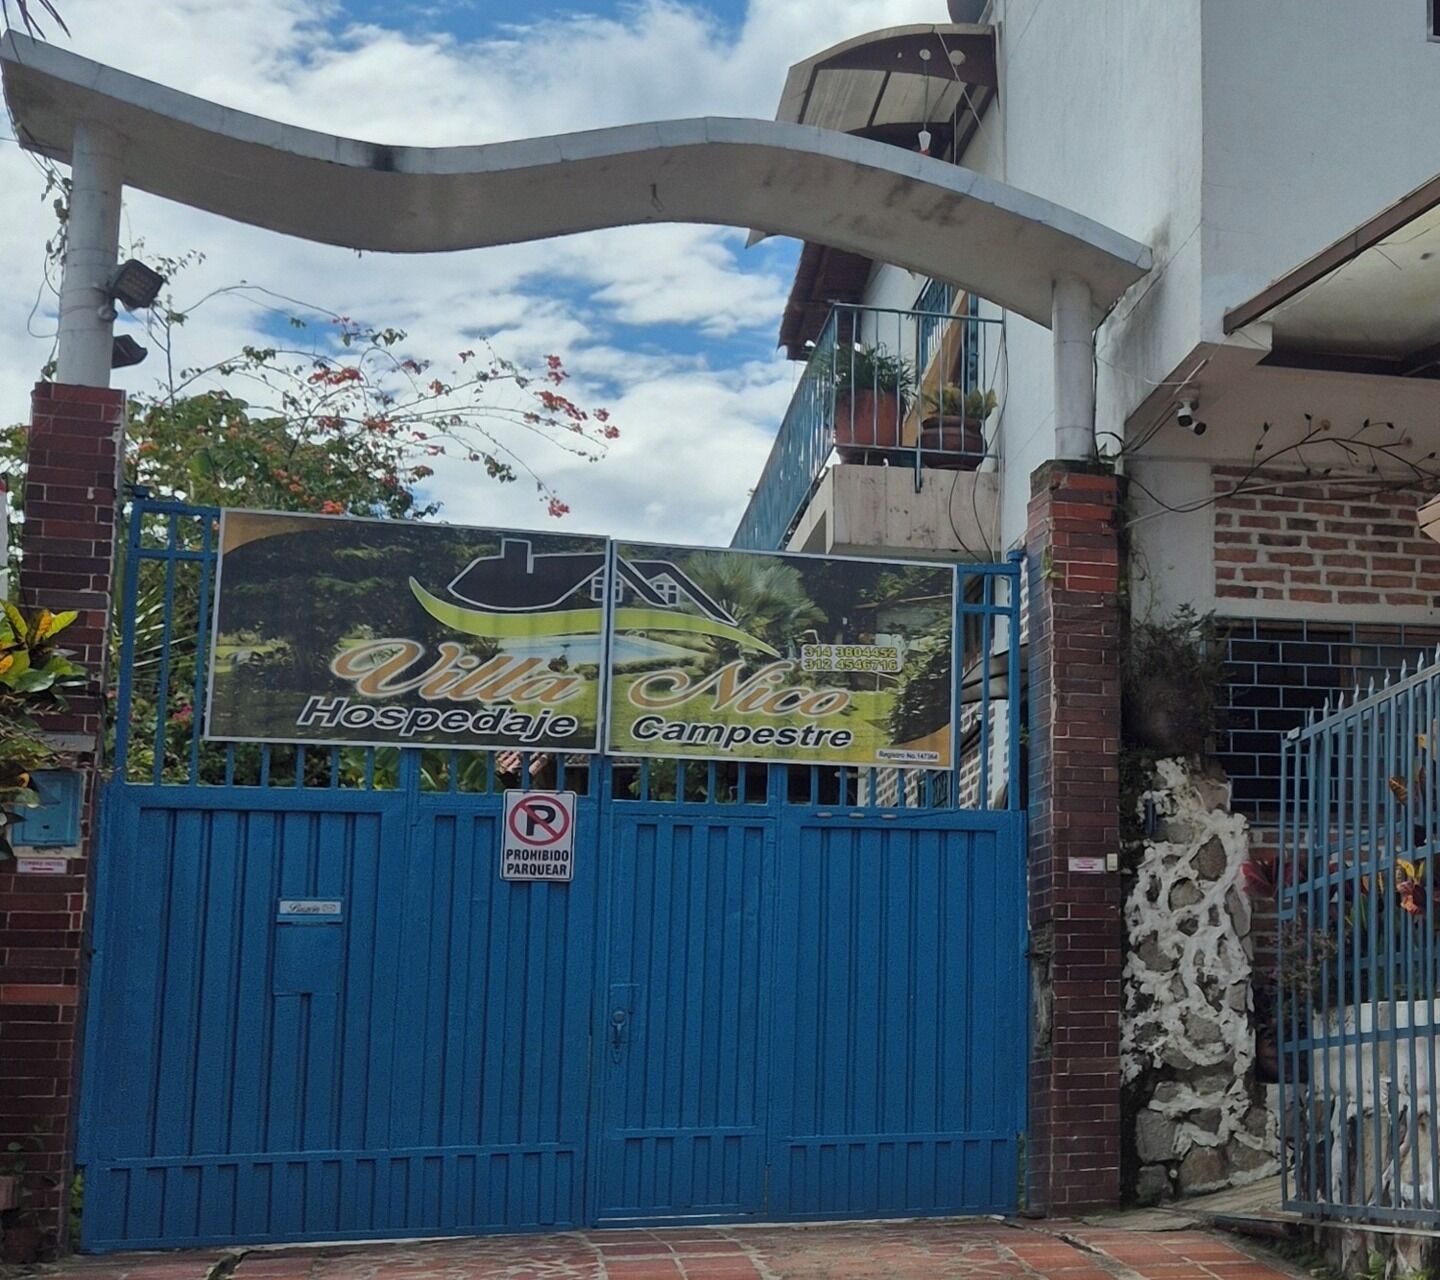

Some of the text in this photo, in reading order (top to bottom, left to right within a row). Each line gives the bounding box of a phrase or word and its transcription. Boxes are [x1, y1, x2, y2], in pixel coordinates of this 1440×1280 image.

[804, 646, 897, 659] 314 3804452
[804, 658, 897, 671] 312 4546716
[330, 638, 850, 716] Villa Nico
[296, 695, 854, 753] Hospedaje Campestre
[506, 849, 569, 863] PROHIBIDO
[506, 863, 568, 877] PARQUEAR
